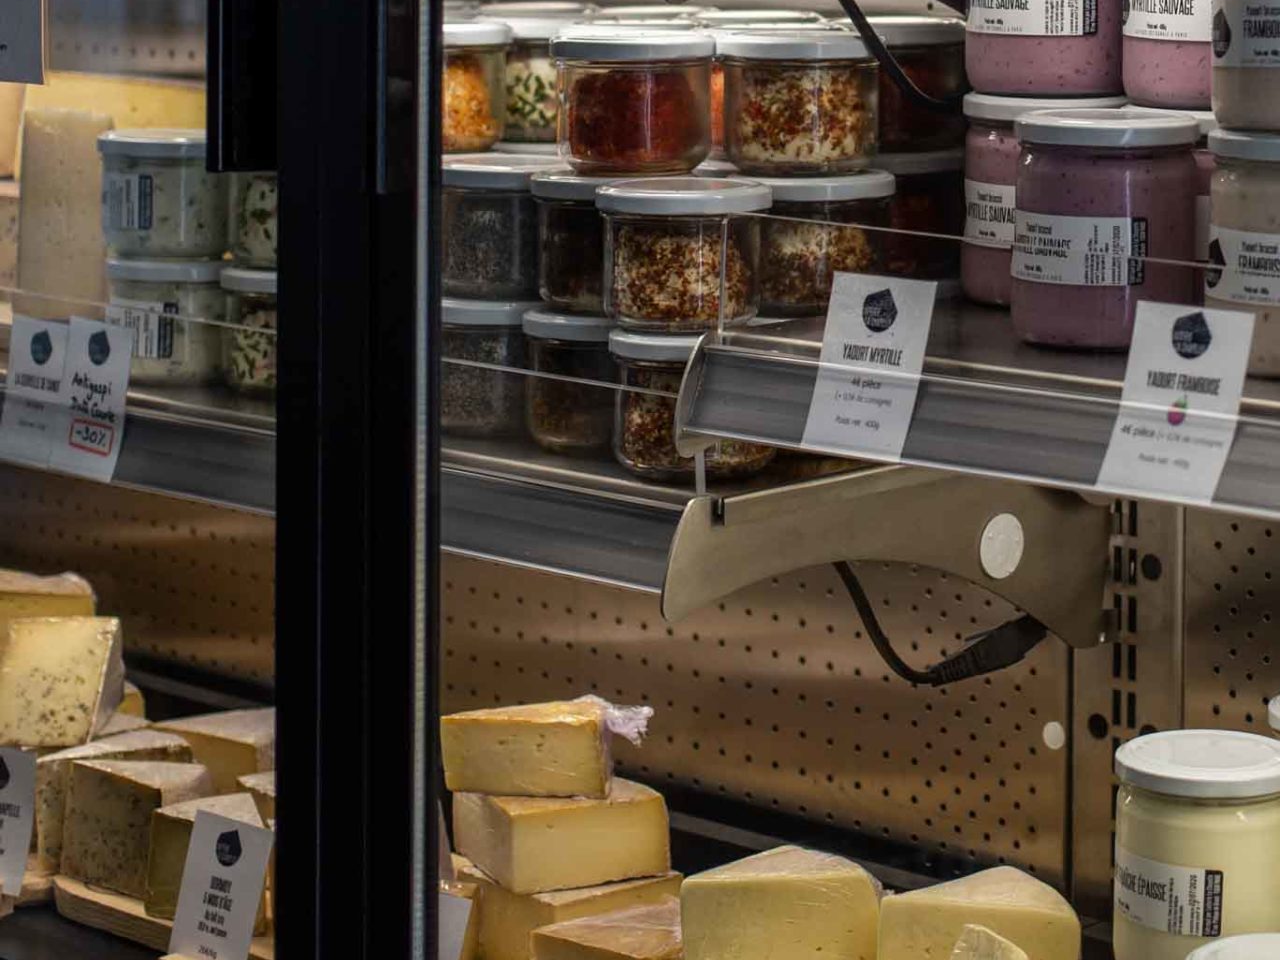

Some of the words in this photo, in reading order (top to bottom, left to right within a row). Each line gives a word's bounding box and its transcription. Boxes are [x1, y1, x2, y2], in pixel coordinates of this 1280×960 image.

[842, 342, 869, 362] YAOURT
[869, 346, 903, 368] MYRTILLE
[75, 426, 107, 448] -30%
[1137, 874, 1167, 902] ÉPAISSE
